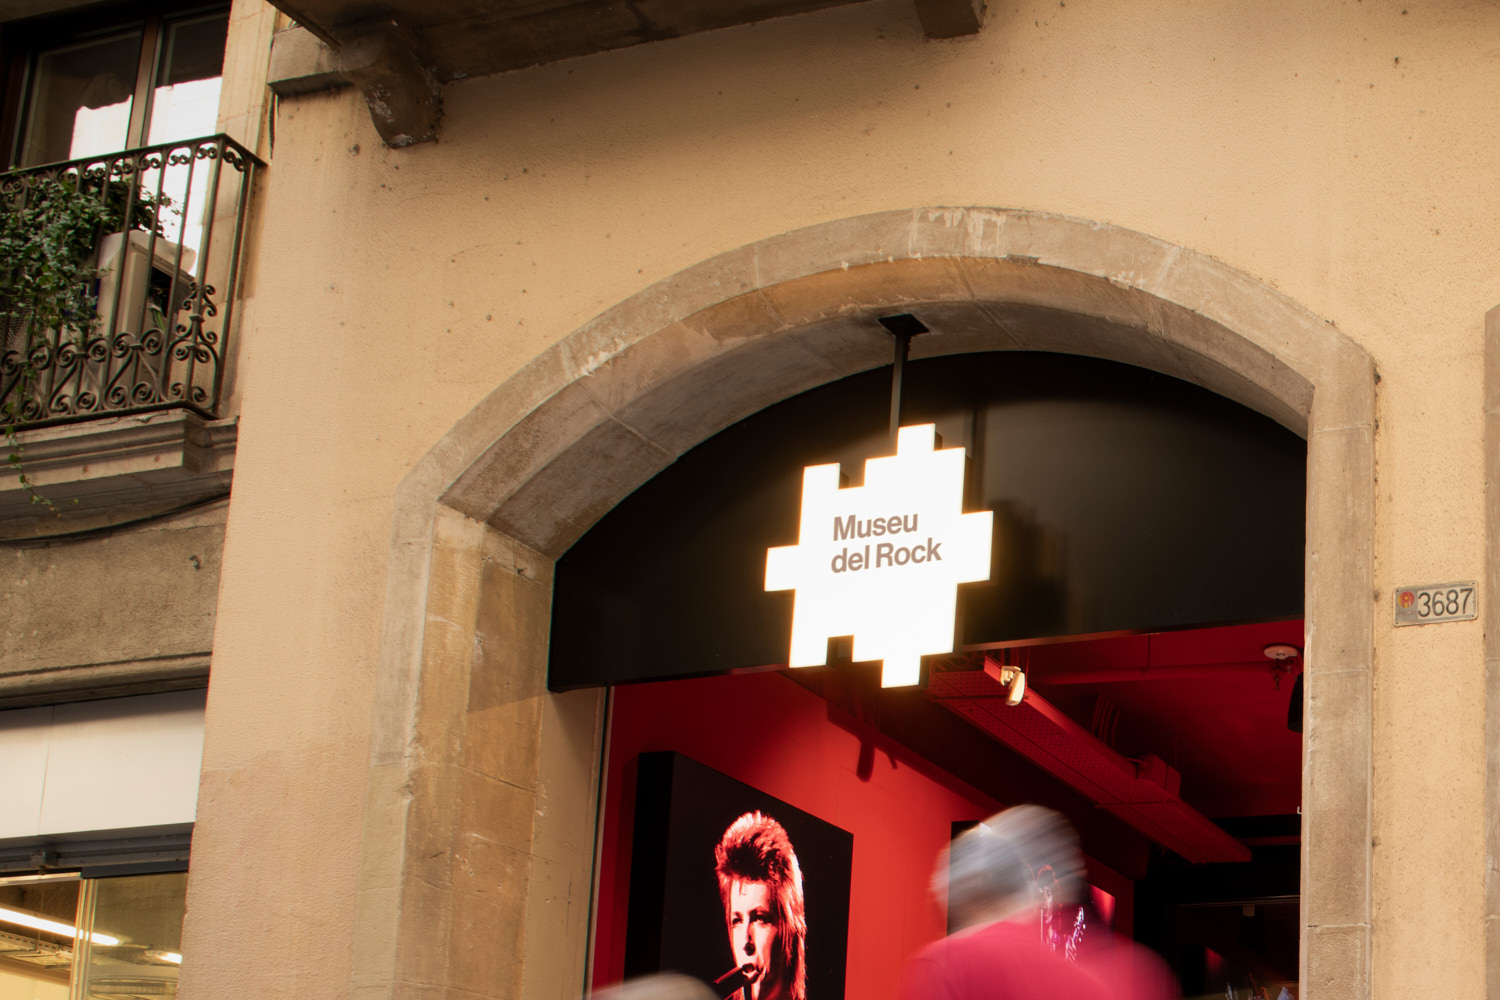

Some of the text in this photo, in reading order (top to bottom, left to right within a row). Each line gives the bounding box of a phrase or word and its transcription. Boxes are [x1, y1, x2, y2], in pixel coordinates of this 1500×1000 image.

[833, 514, 919, 541] Museu
[831, 538, 942, 573] del Rock
[1418, 587, 1473, 617] 3687
